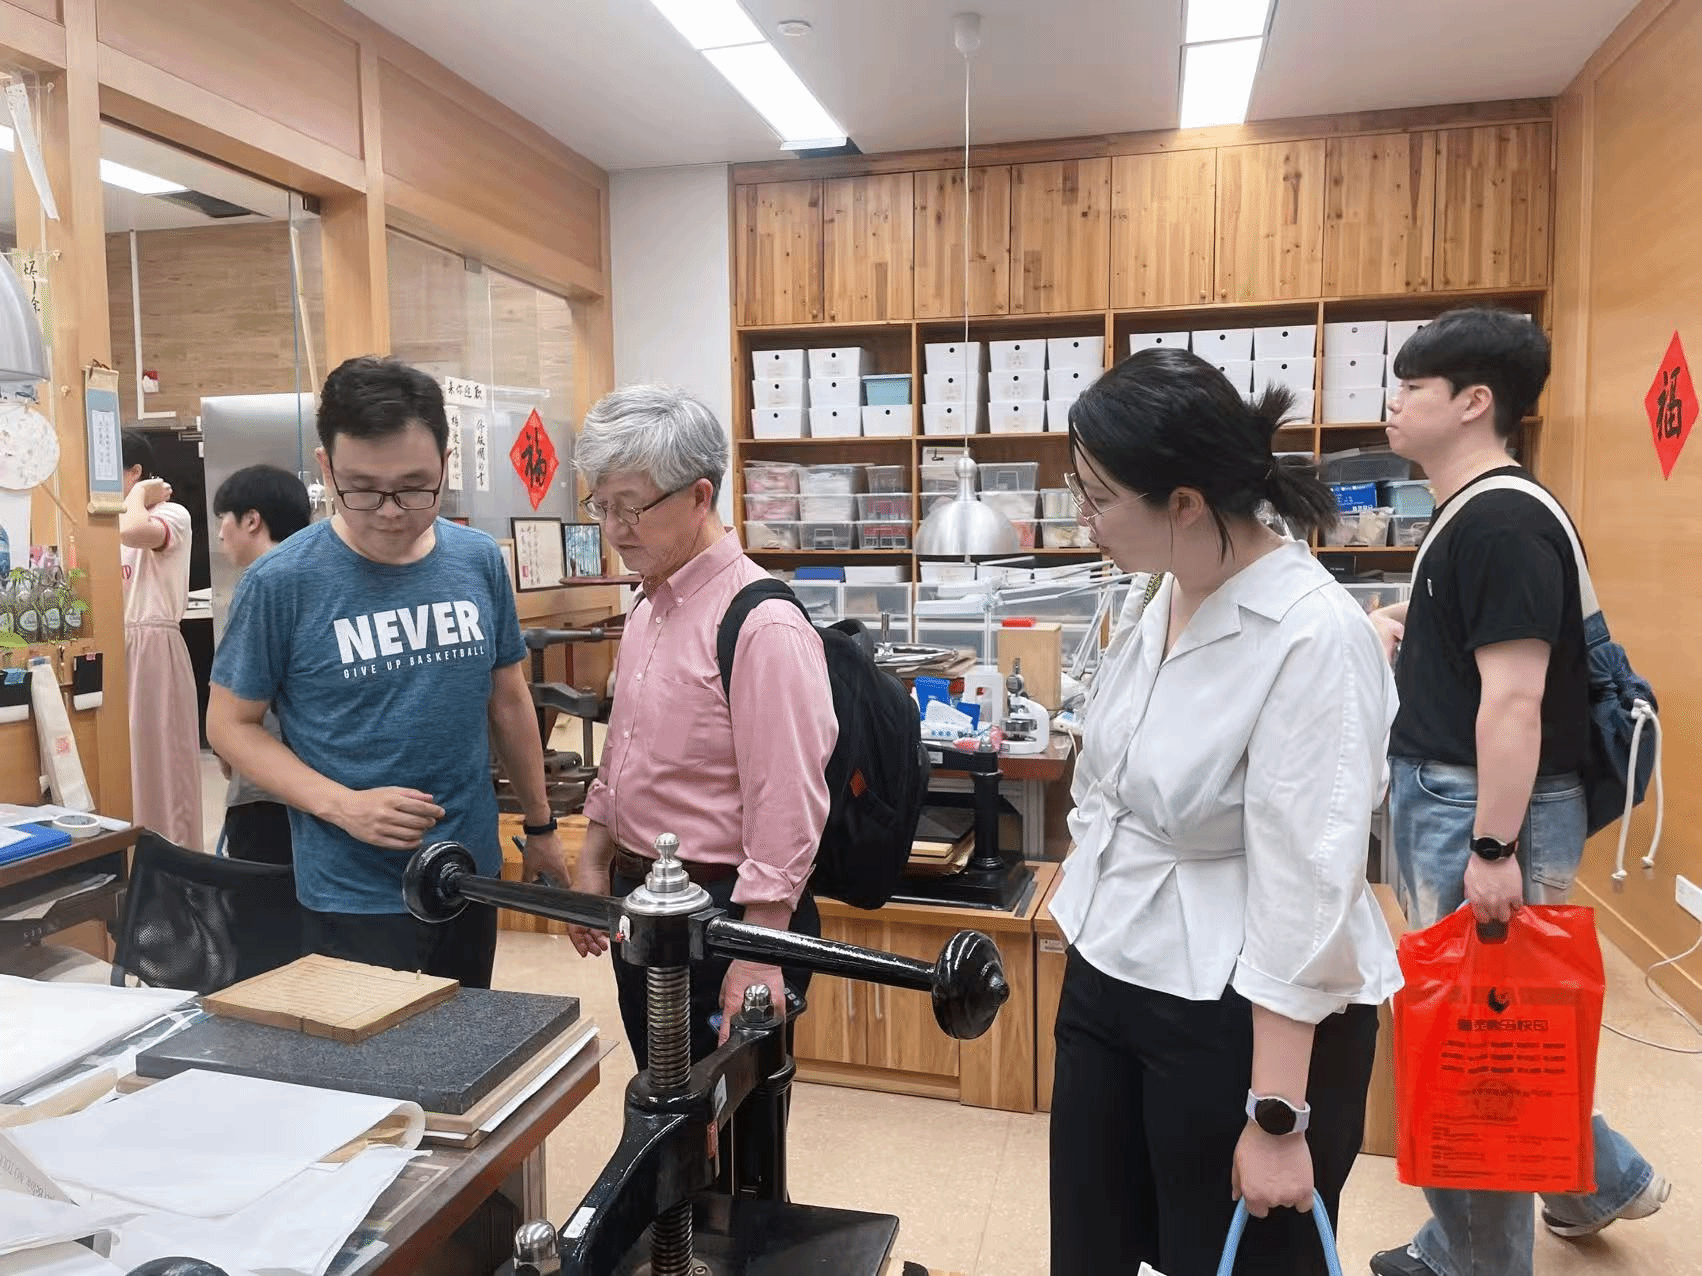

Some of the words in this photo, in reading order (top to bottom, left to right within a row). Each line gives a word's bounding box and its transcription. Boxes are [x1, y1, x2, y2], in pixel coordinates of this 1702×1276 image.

[1656, 366, 1682, 442] 福
[520, 426, 547, 489] 福
[333, 600, 485, 664] NEVER
[343, 664, 377, 679] GIVE
[386, 659, 401, 671] UP
[409, 645, 485, 666] BASKETBALL
